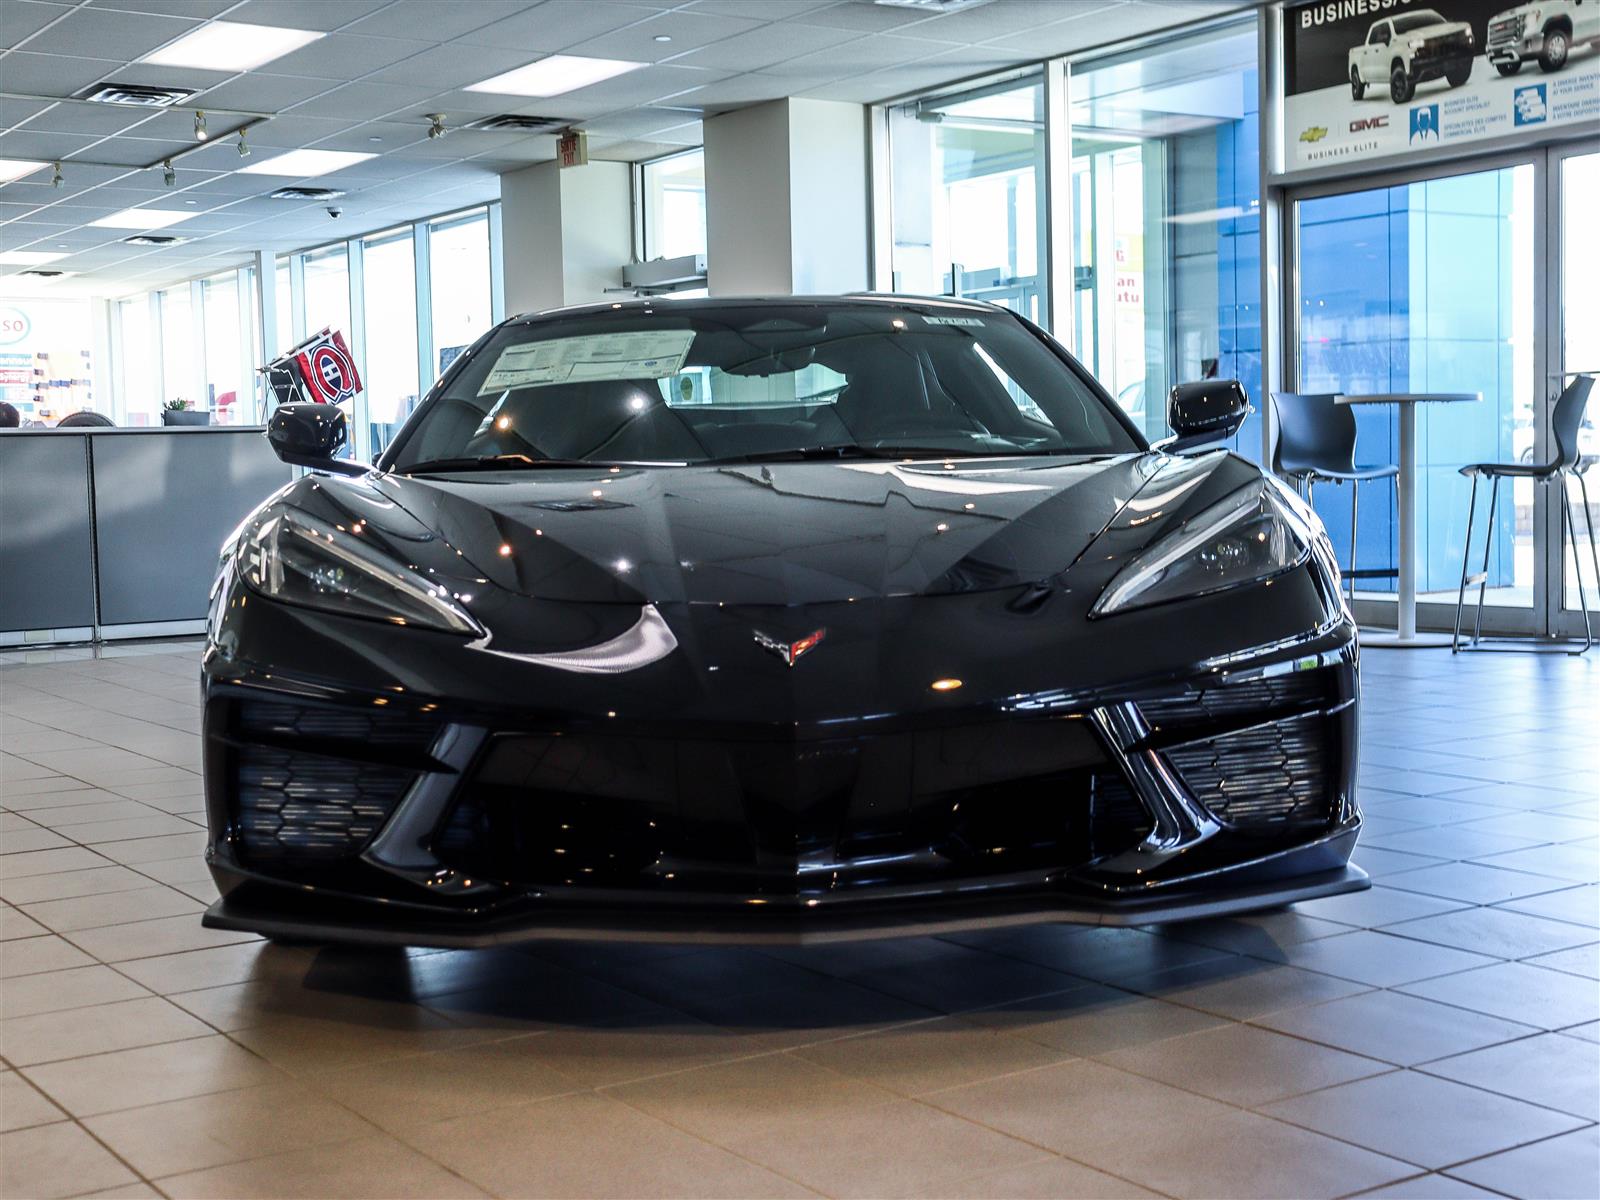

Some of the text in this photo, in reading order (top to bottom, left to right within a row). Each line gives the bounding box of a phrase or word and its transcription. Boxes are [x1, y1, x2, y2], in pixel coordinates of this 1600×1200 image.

[1349, 114, 1390, 133] GMC
[1308, 141, 1378, 160] BUSINESS ELITE
